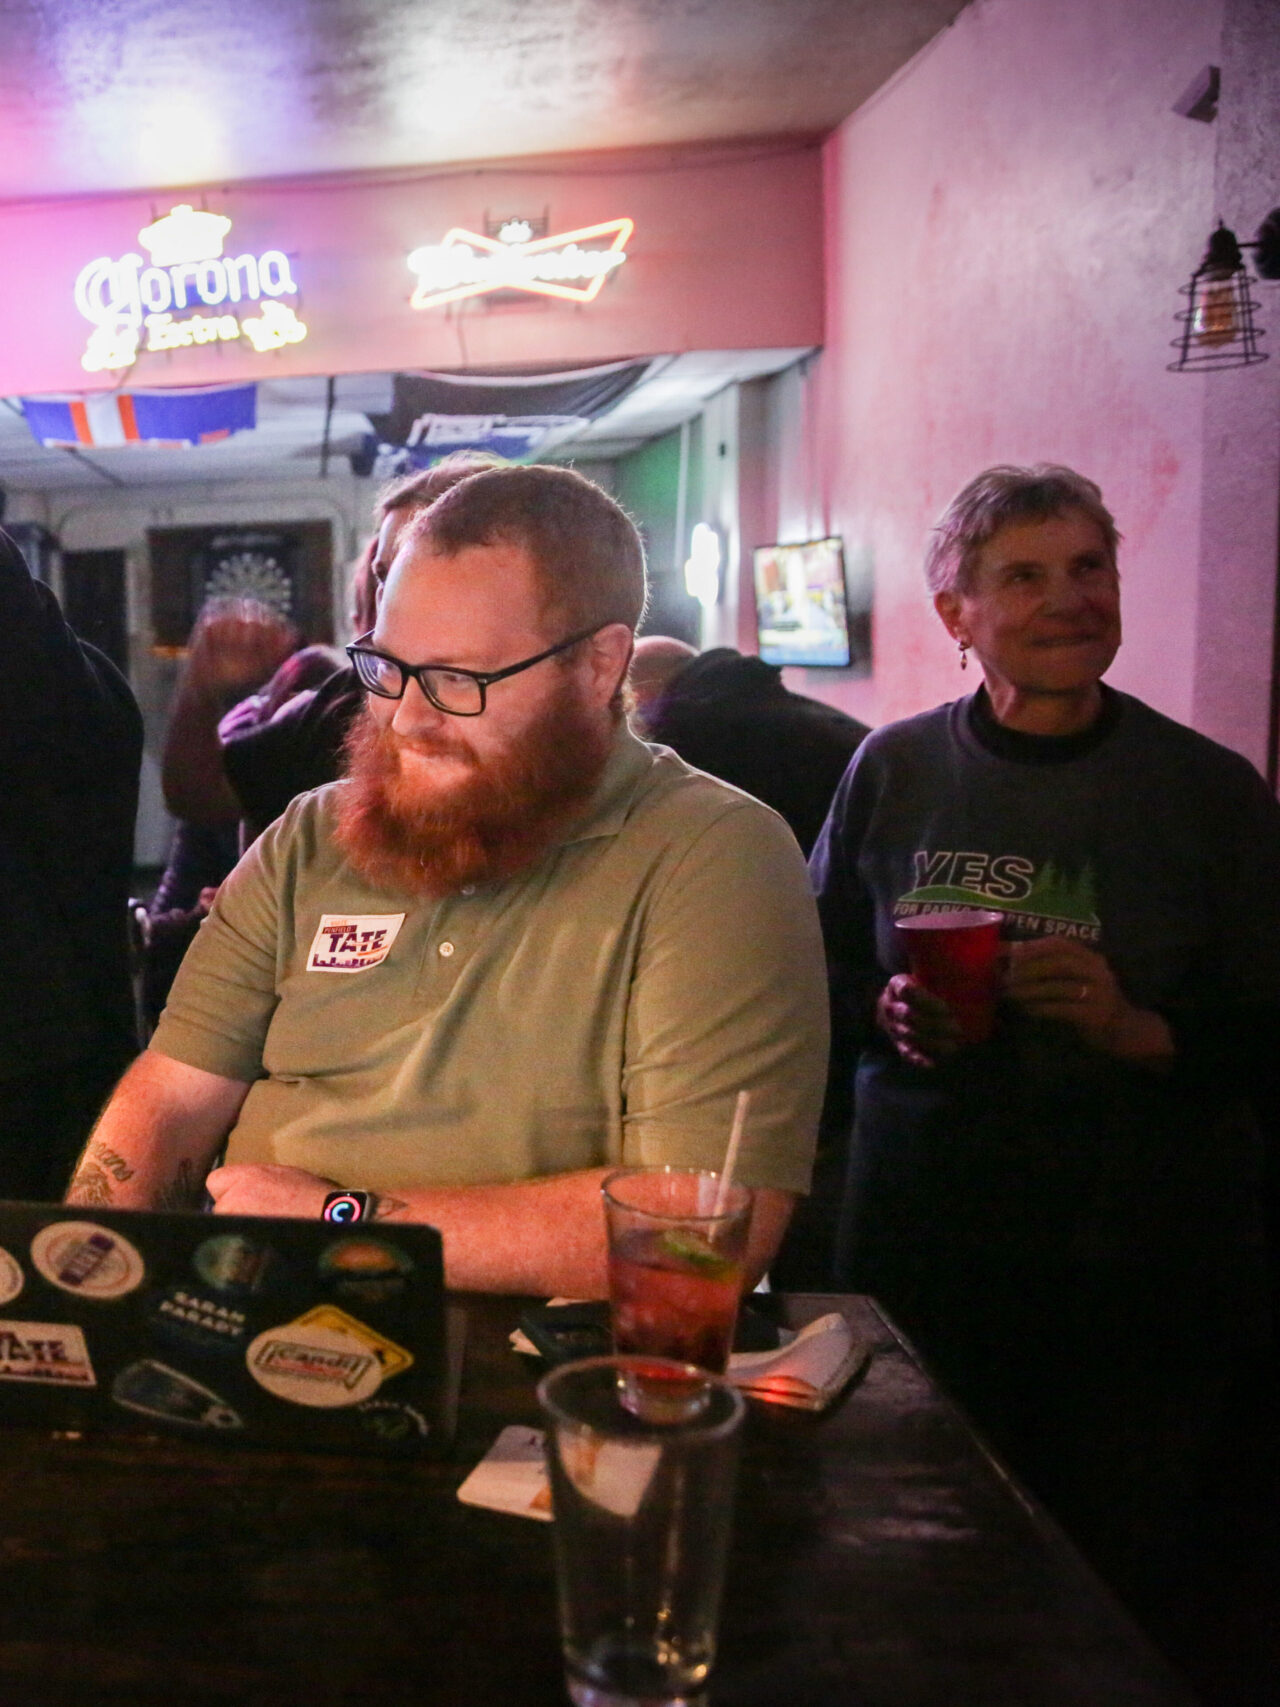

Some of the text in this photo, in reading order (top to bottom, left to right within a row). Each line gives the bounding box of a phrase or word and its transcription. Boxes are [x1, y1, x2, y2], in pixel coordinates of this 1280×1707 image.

[74, 250, 298, 329] Corona
[914, 850, 1034, 901] YES
[328, 929, 388, 953] TATE
[893, 902, 919, 916] FOR
[1005, 912, 1040, 931] PEN
[1044, 918, 1101, 941] SPACE
